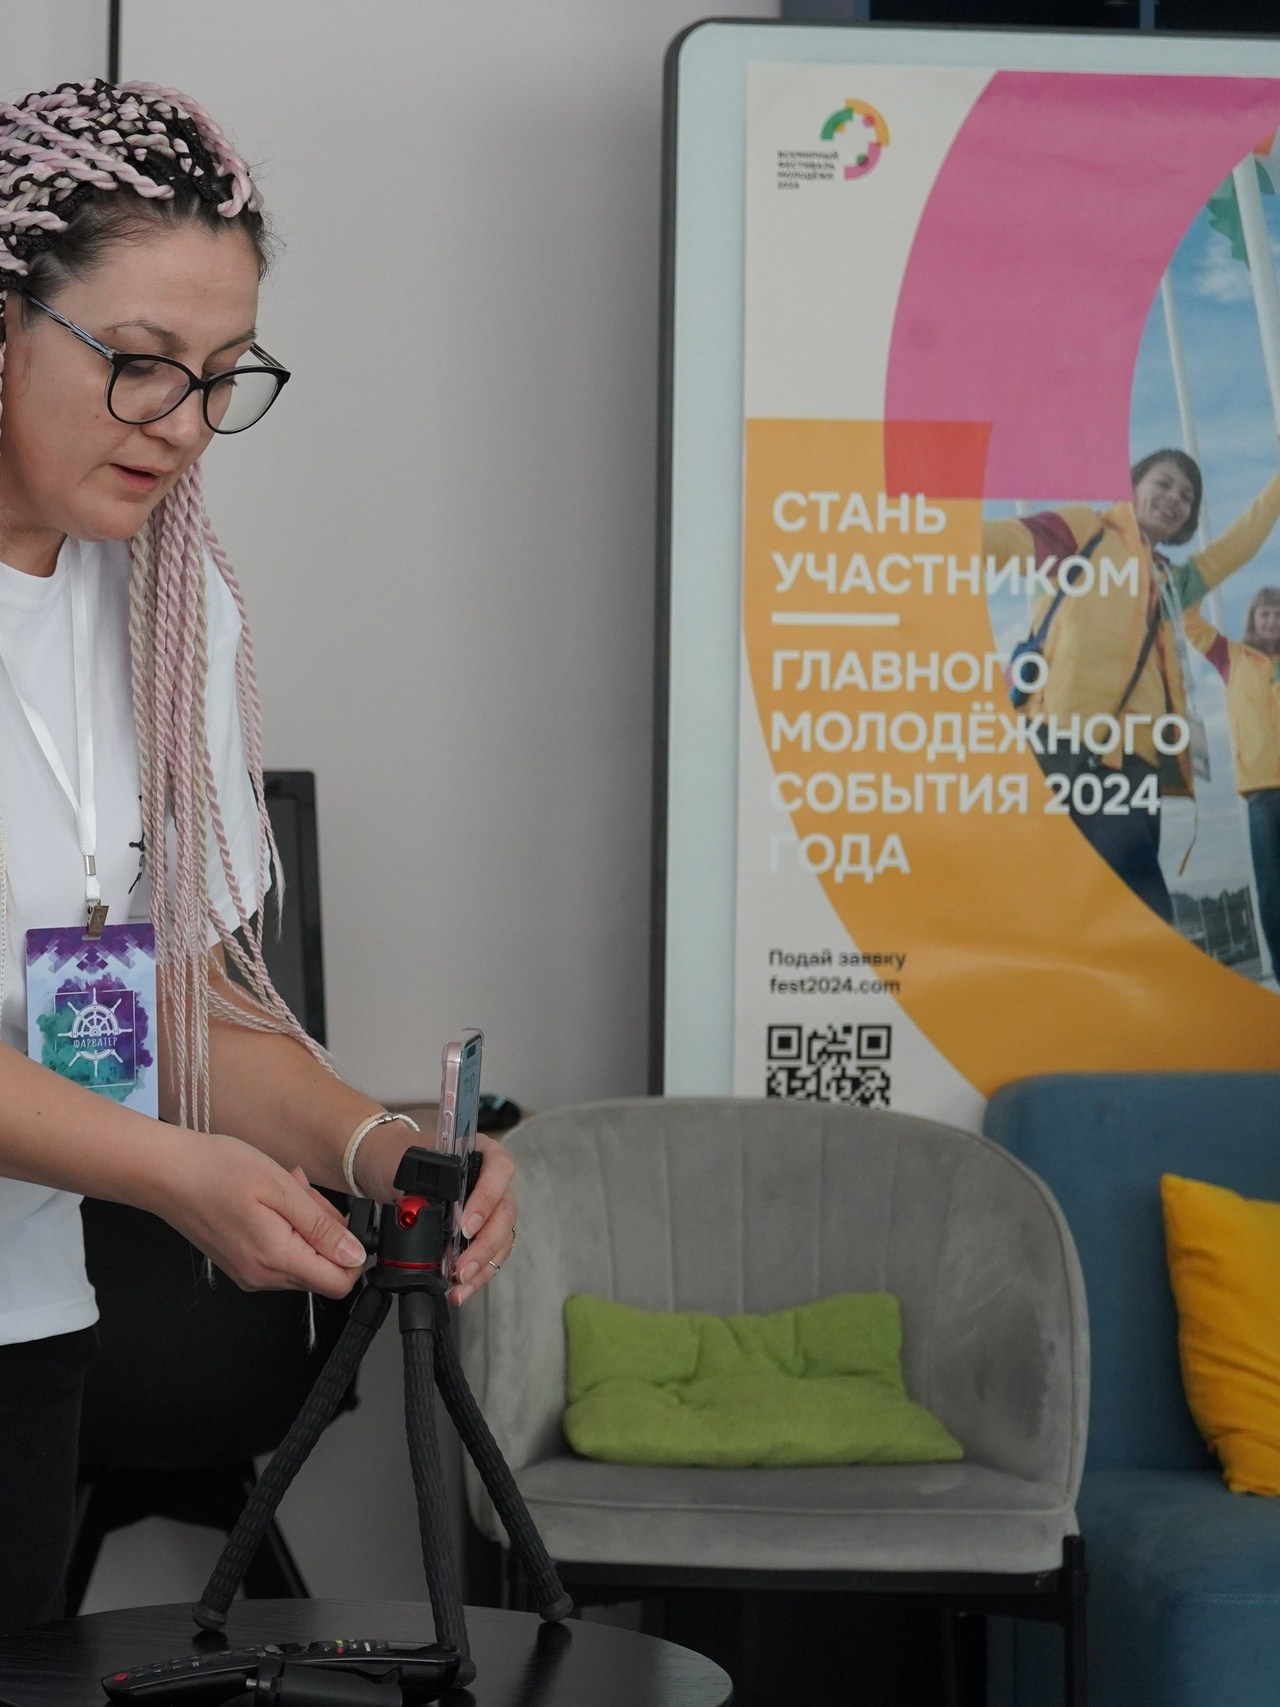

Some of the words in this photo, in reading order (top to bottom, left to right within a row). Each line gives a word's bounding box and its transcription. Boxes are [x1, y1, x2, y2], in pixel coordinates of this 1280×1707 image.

[772, 491, 947, 534] СТАНЬ
[771, 552, 1140, 598] УЧАСТНИКОМ
[772, 650, 1049, 693] ГЛАВНОГО
[771, 702, 1191, 762] МОЛОДЁЖНОГО
[769, 772, 1028, 815] СОБЫТИЯ
[1043, 773, 1161, 816] 2024
[769, 833, 910, 884] ГОДА
[769, 948, 833, 969] Подай
[838, 952, 907, 972] заявку
[770, 975, 901, 995] fest2024.com
[73, 1036, 118, 1048] ФАРВАТЕР
